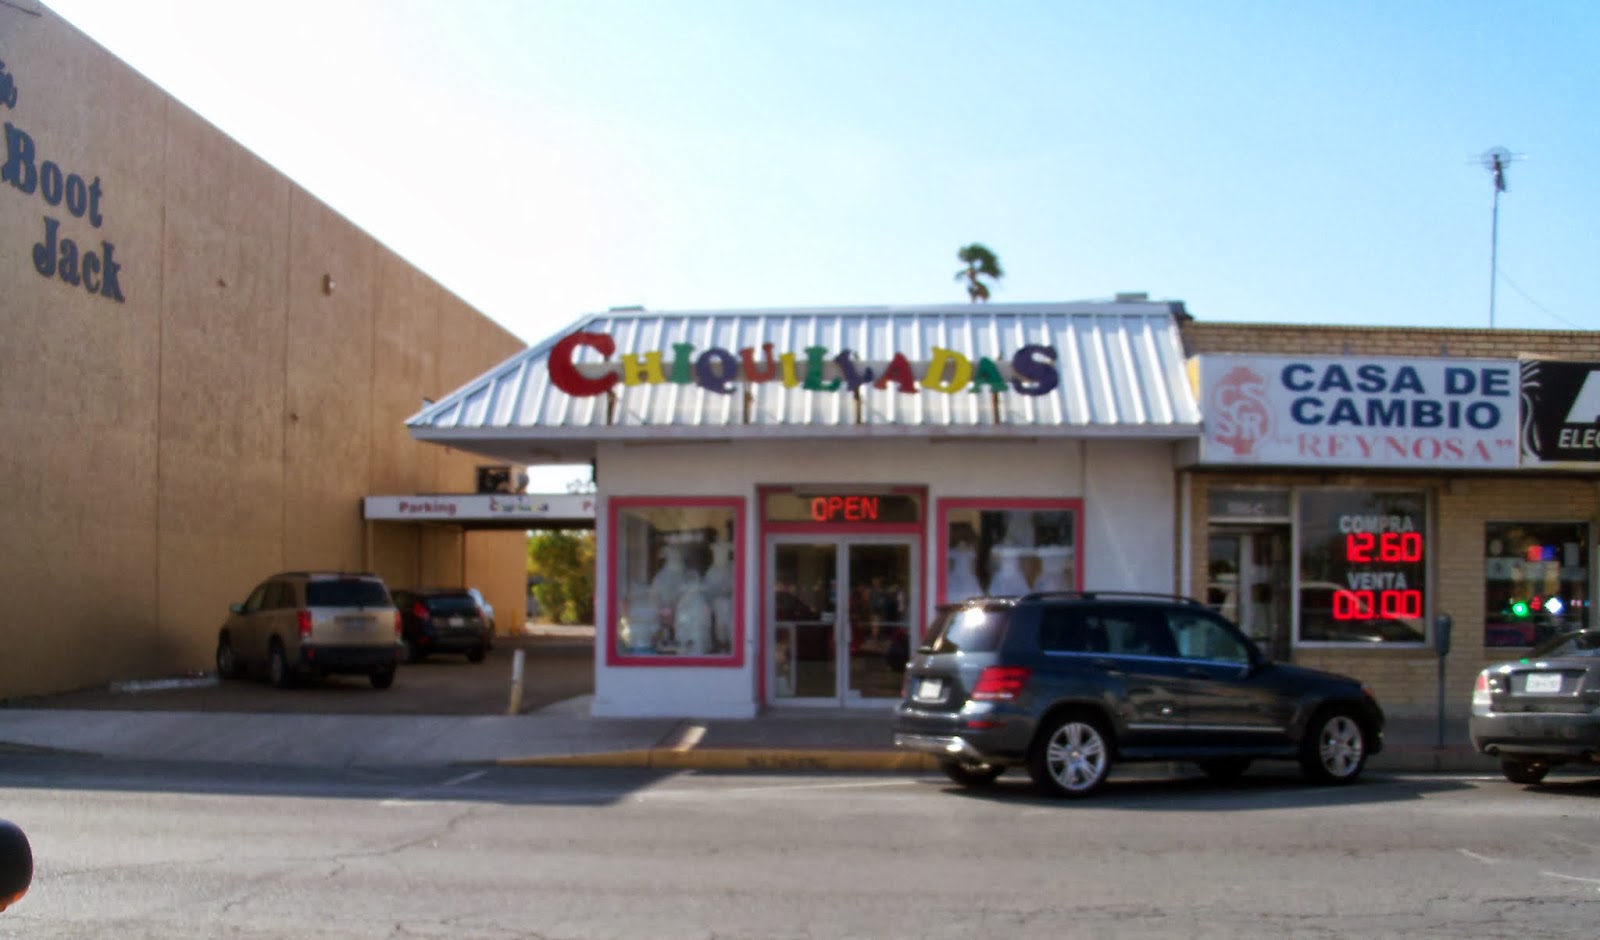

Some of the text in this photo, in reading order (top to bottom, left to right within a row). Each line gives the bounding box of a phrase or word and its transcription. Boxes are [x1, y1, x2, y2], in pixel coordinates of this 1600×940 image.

[1, 121, 103, 229] Boot
[32, 215, 126, 304] Jack
[547, 331, 1060, 398] CHIQUILLADAS
[1281, 363, 1511, 396] CASA DE
[1290, 397, 1501, 430] CAMBIO
[399, 501, 457, 515] Parking
[811, 496, 879, 521] OPEN
[1339, 515, 1415, 533] COMPRA
[1346, 532, 1422, 563] 12.60
[1348, 571, 1406, 590] VENTA
[1332, 589, 1422, 620] 00.00
